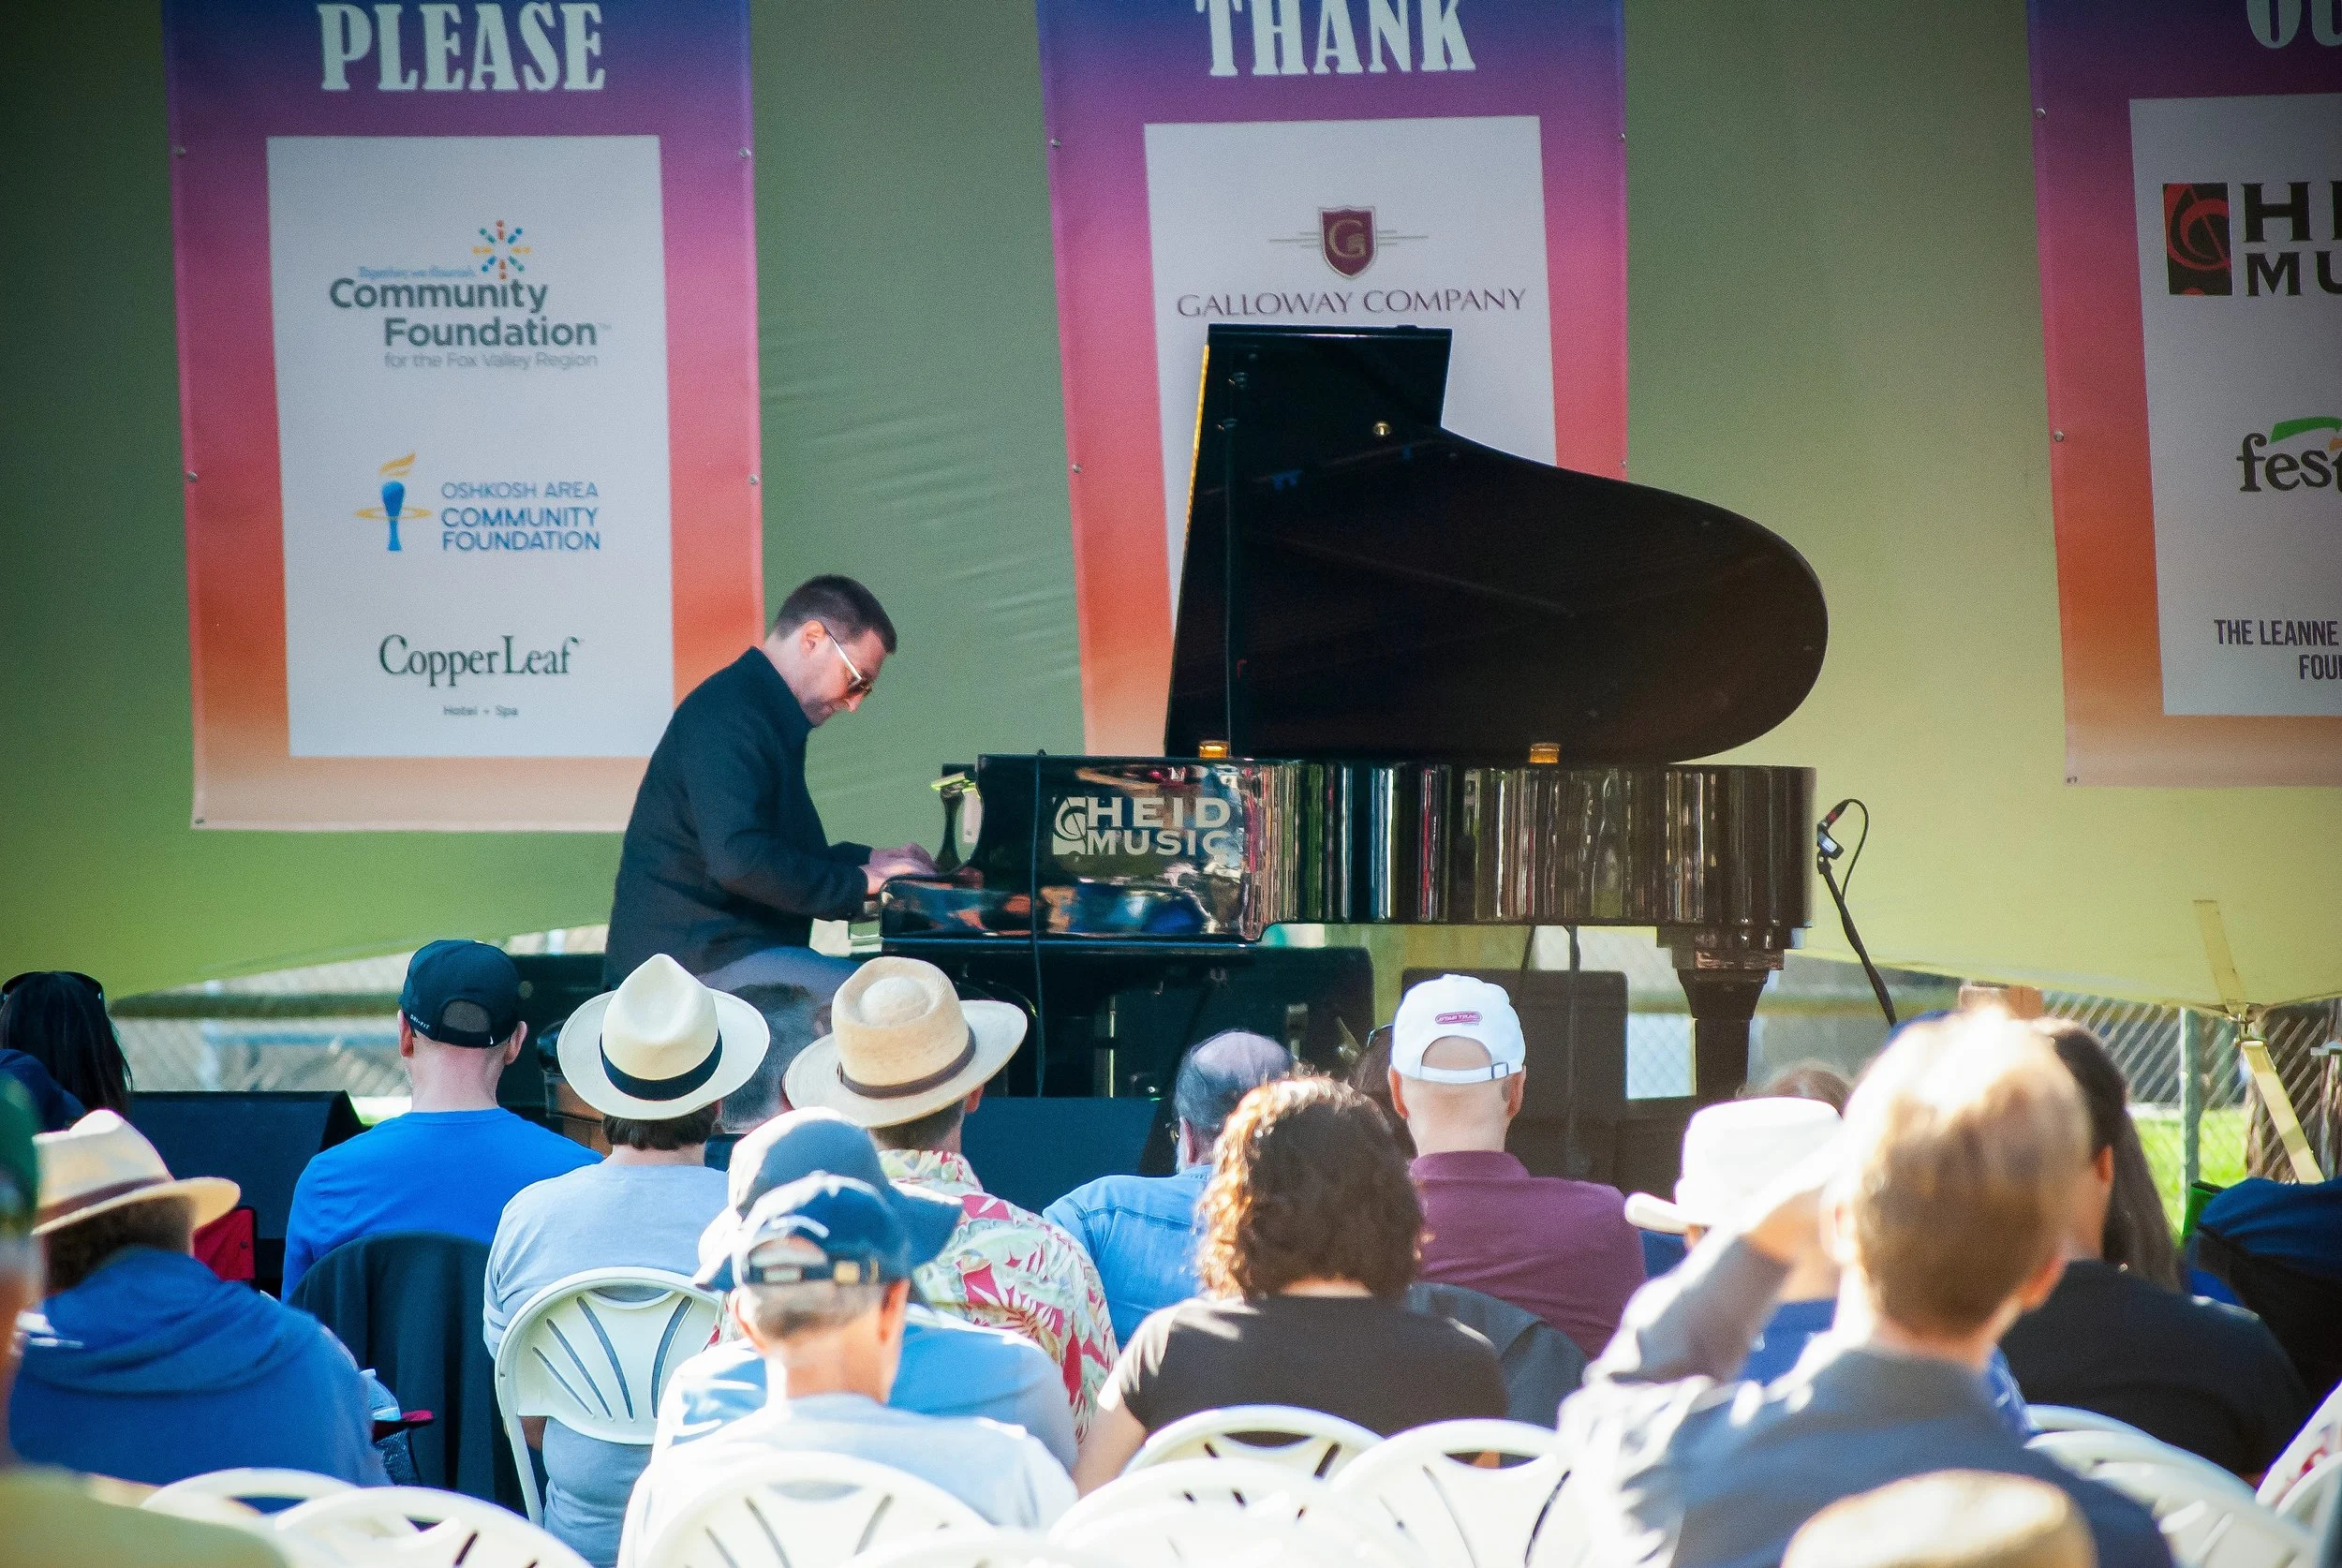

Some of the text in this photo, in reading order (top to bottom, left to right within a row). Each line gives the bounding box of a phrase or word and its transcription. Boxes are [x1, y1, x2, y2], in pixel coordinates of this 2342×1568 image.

[318, 2, 606, 92] PLEASE
[1195, 0, 1476, 77] THANK
[329, 277, 549, 313] Community
[1177, 288, 1526, 317] GALLOWAY COMPANY
[384, 316, 598, 347] Foundation
[384, 351, 598, 371] for the Fox Valley Region
[440, 481, 599, 499] OSHKOSH AREA
[440, 507, 599, 528] COMMUNITY
[442, 530, 600, 552] FOUNDATION
[2214, 619, 2339, 646] THE LEANNE
[378, 634, 581, 688] CopperLeaf
[2298, 654, 2342, 681] FOU
[1087, 796, 1231, 829] HEID
[1087, 829, 1230, 855] MUSIC
